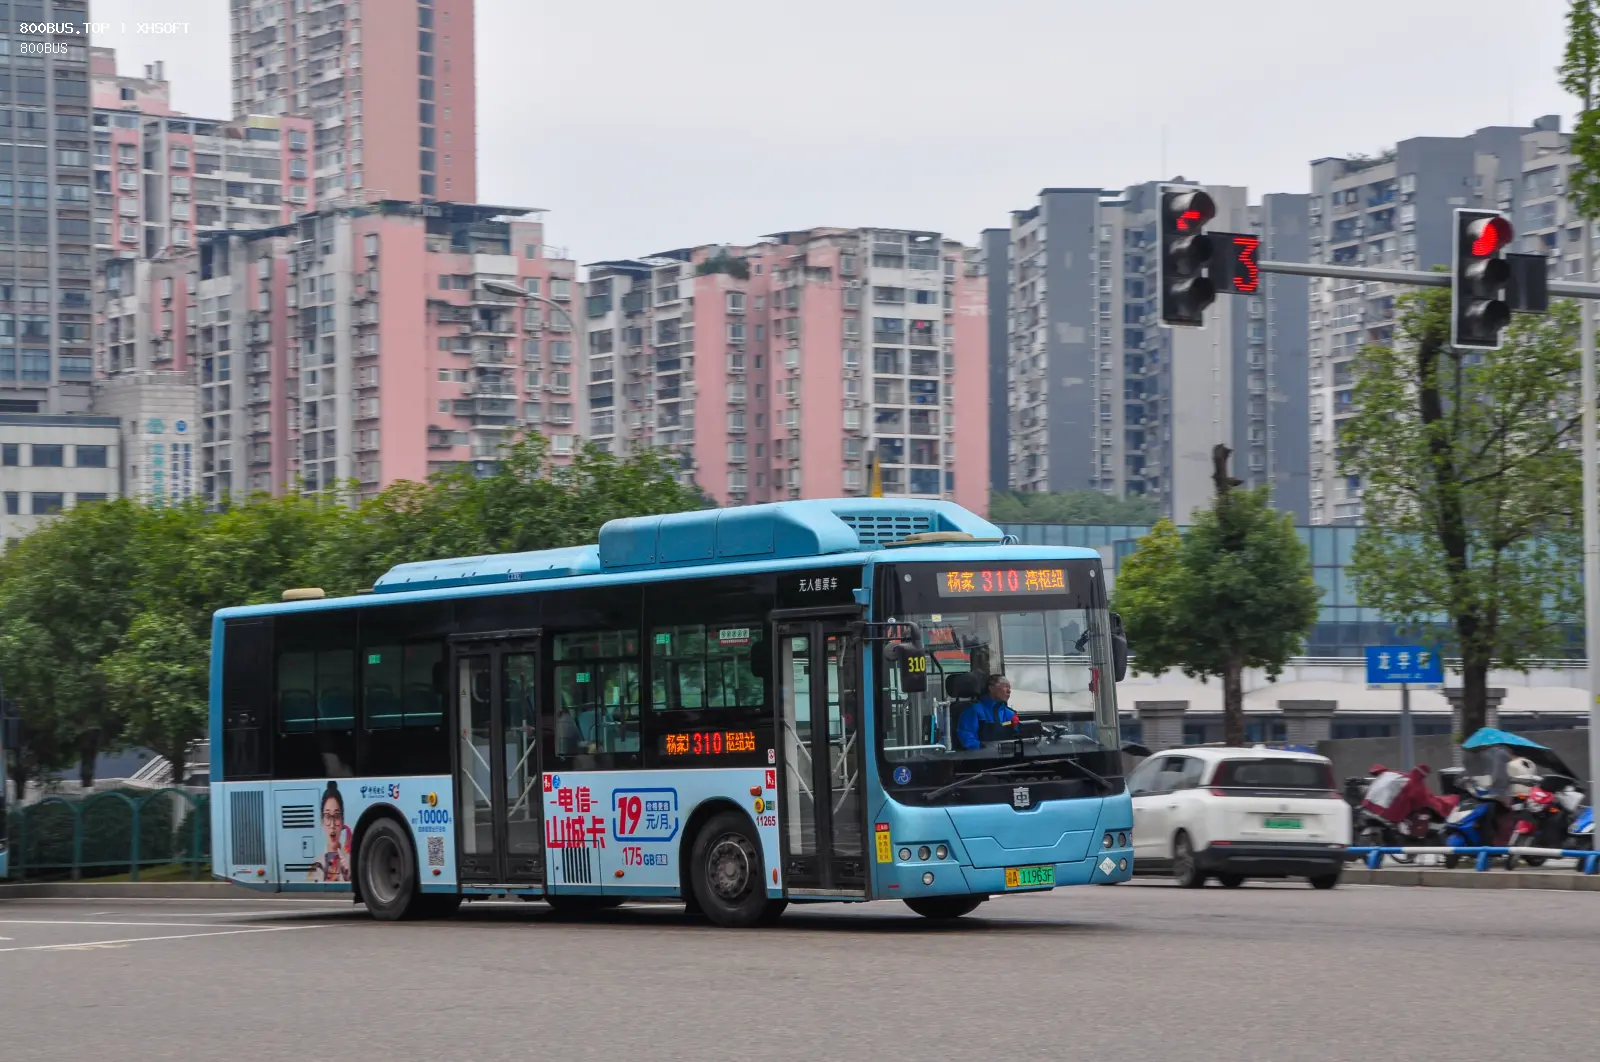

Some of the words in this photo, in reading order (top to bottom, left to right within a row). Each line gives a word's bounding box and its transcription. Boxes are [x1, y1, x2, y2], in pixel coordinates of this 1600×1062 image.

[1233, 237, 1259, 291] 3
[799, 577, 838, 592] 无人售票车
[946, 571, 975, 592] 杨家
[981, 569, 1019, 592] 310
[1025, 568, 1065, 591] 湾枢纽
[908, 656, 926, 672] 310
[693, 731, 722, 754] 310
[558, 786, 591, 812] 电信
[618, 796, 642, 834] 19
[756, 816, 776, 826] 11265
[546, 815, 606, 848] 山城卡
